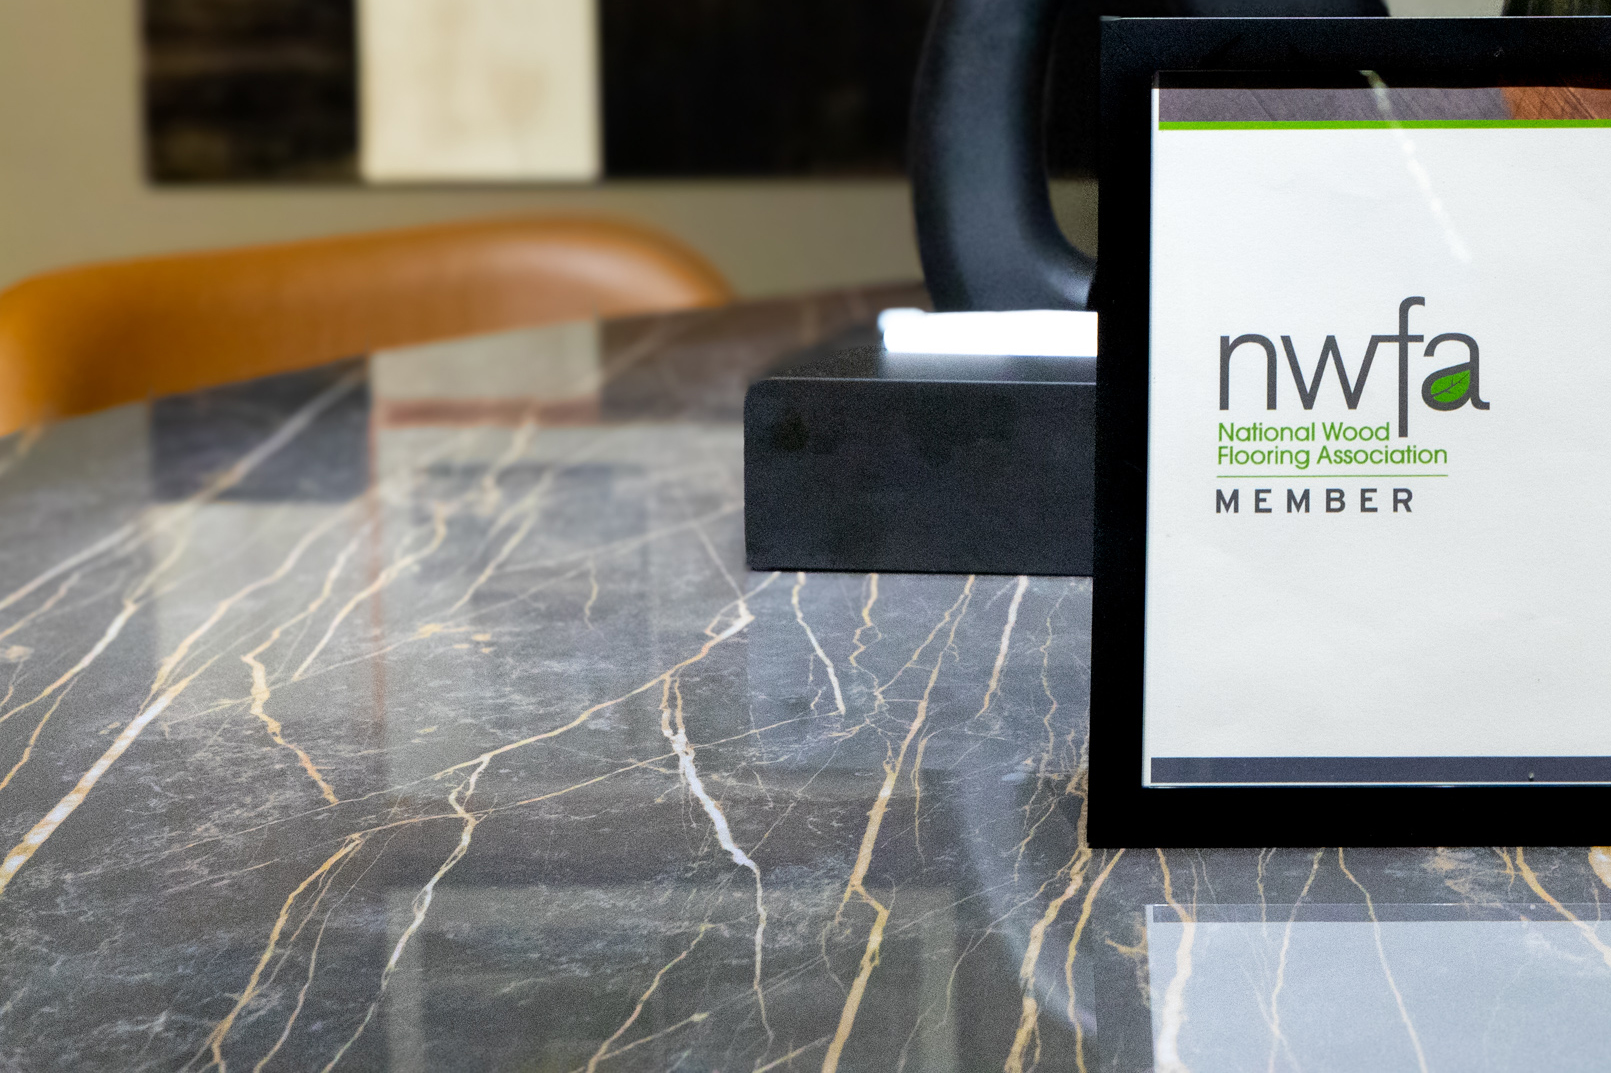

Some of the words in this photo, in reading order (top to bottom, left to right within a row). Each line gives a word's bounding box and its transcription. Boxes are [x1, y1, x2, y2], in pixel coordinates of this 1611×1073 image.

[1218, 295, 1491, 438] nwfa
[1218, 421, 1316, 442] National
[1321, 421, 1390, 442] Wood
[1217, 445, 1310, 470] Flooring
[1316, 444, 1448, 465] Association
[1215, 487, 1414, 514] MEMBER
